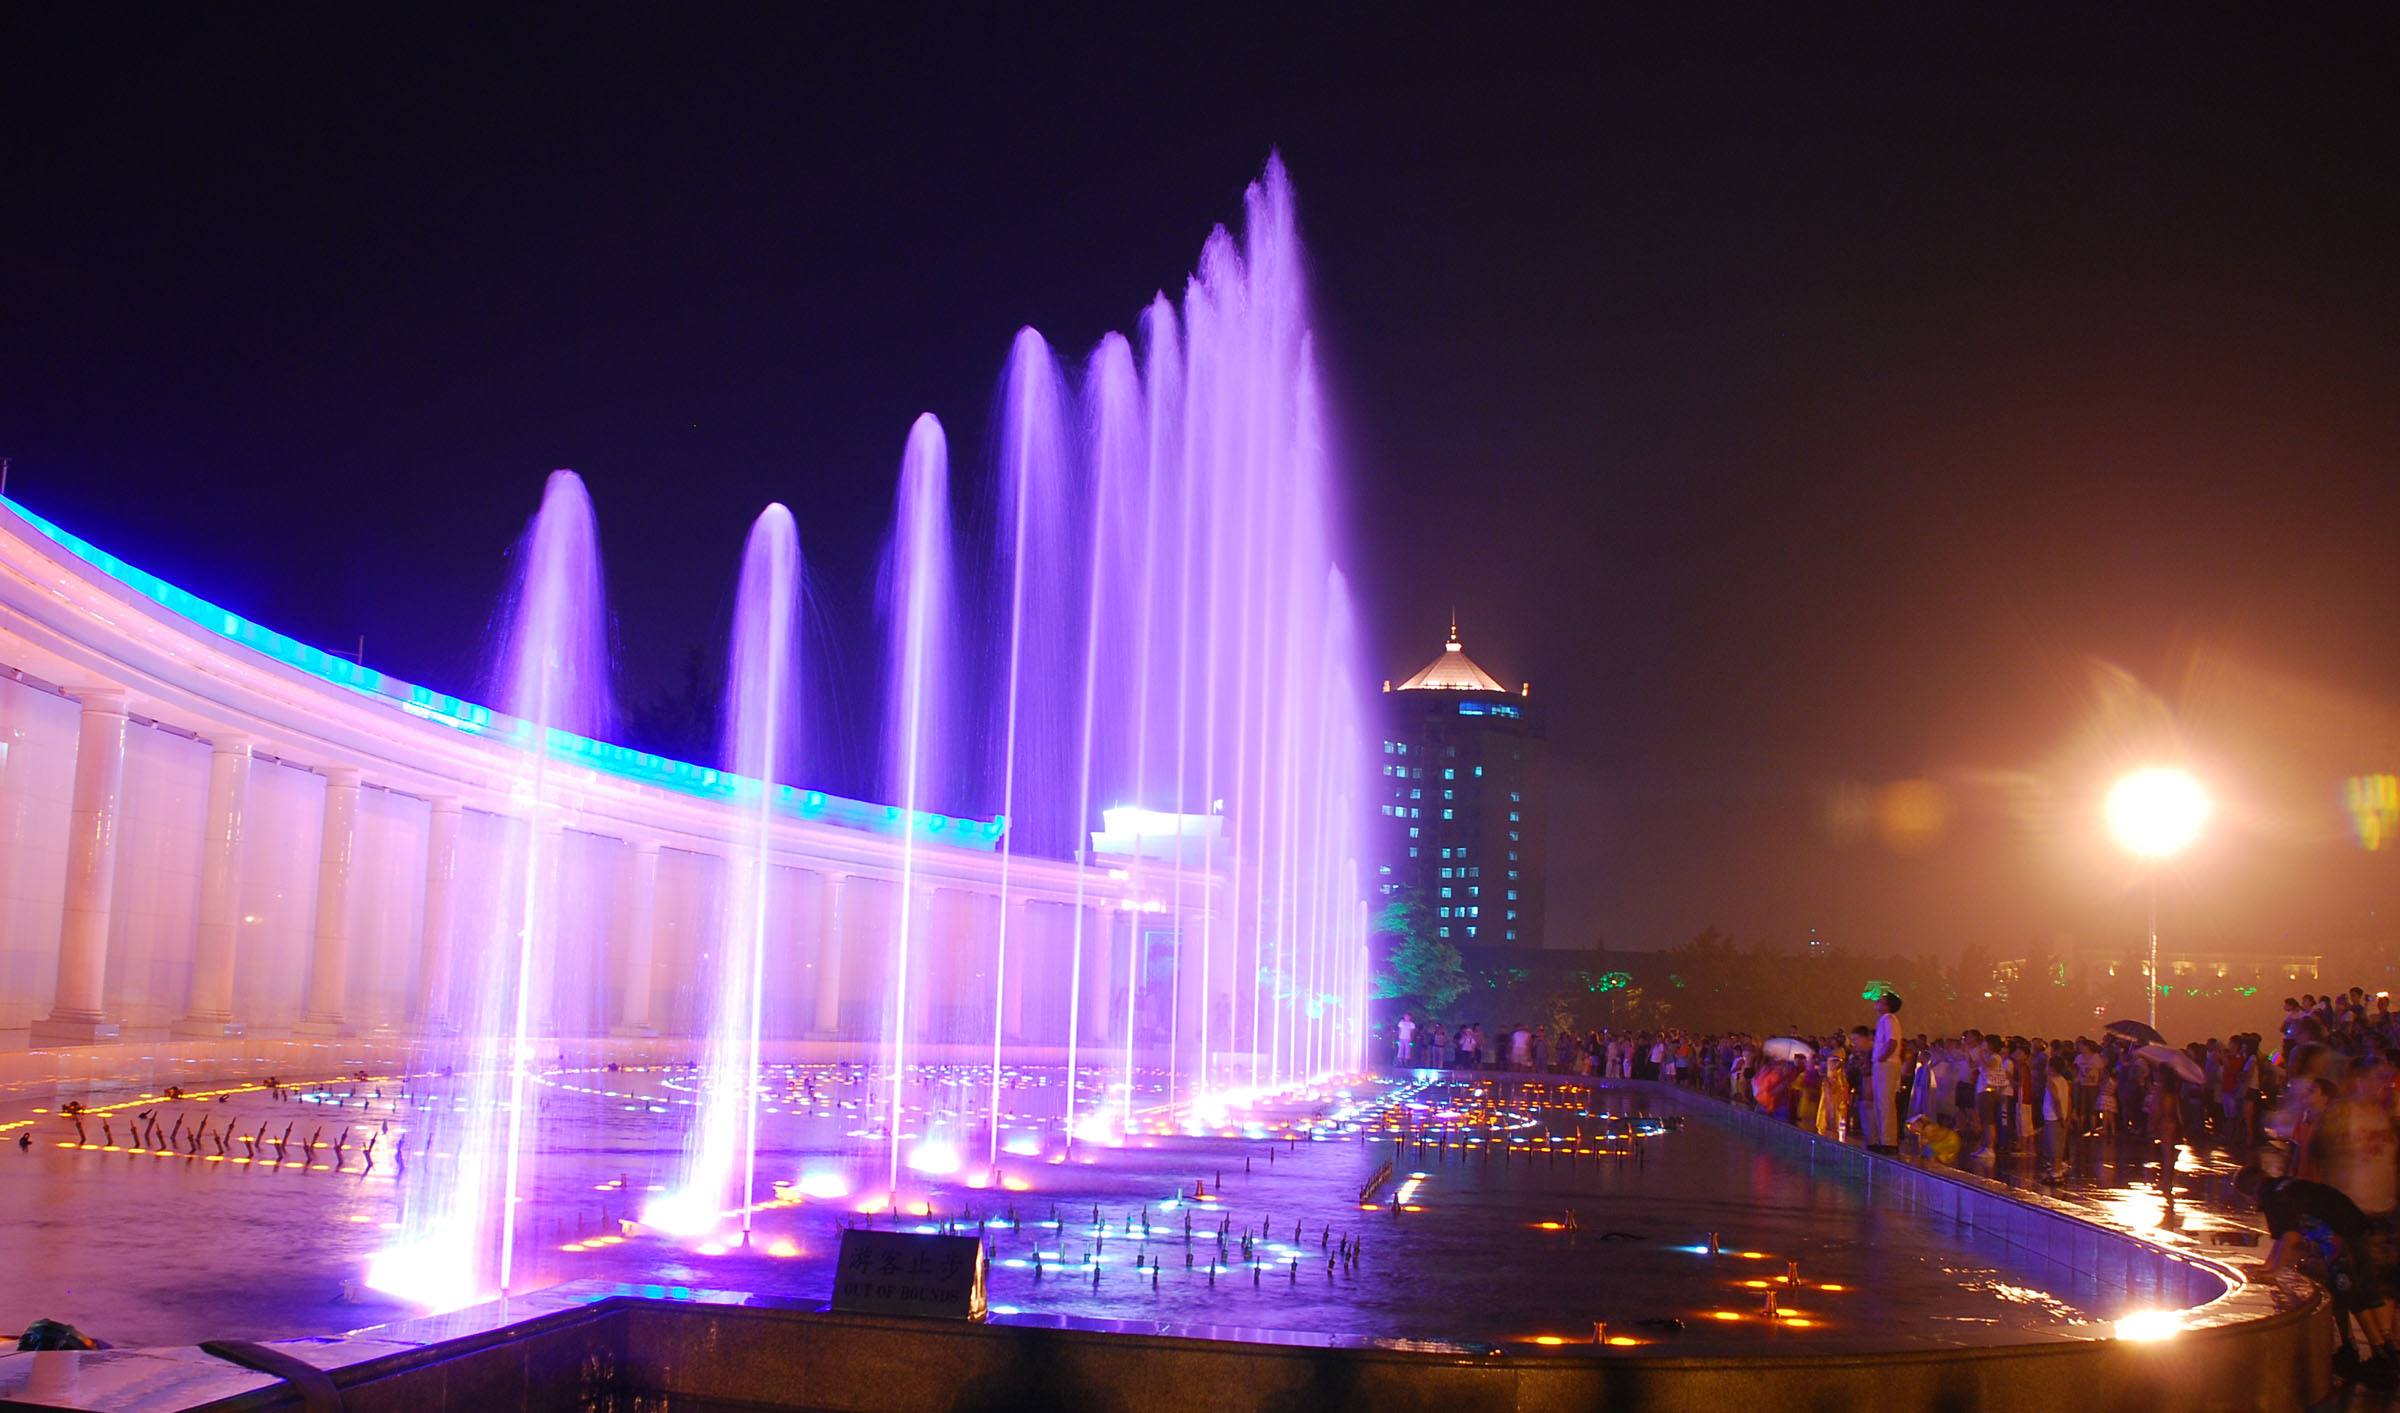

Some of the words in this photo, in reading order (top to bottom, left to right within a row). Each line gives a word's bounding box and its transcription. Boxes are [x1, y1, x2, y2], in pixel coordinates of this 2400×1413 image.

[848, 1247, 963, 1281] 游客止步
[844, 1282, 873, 1297] OUT
[878, 1284, 897, 1299] OF
[900, 1285, 960, 1304] BOUNDS
